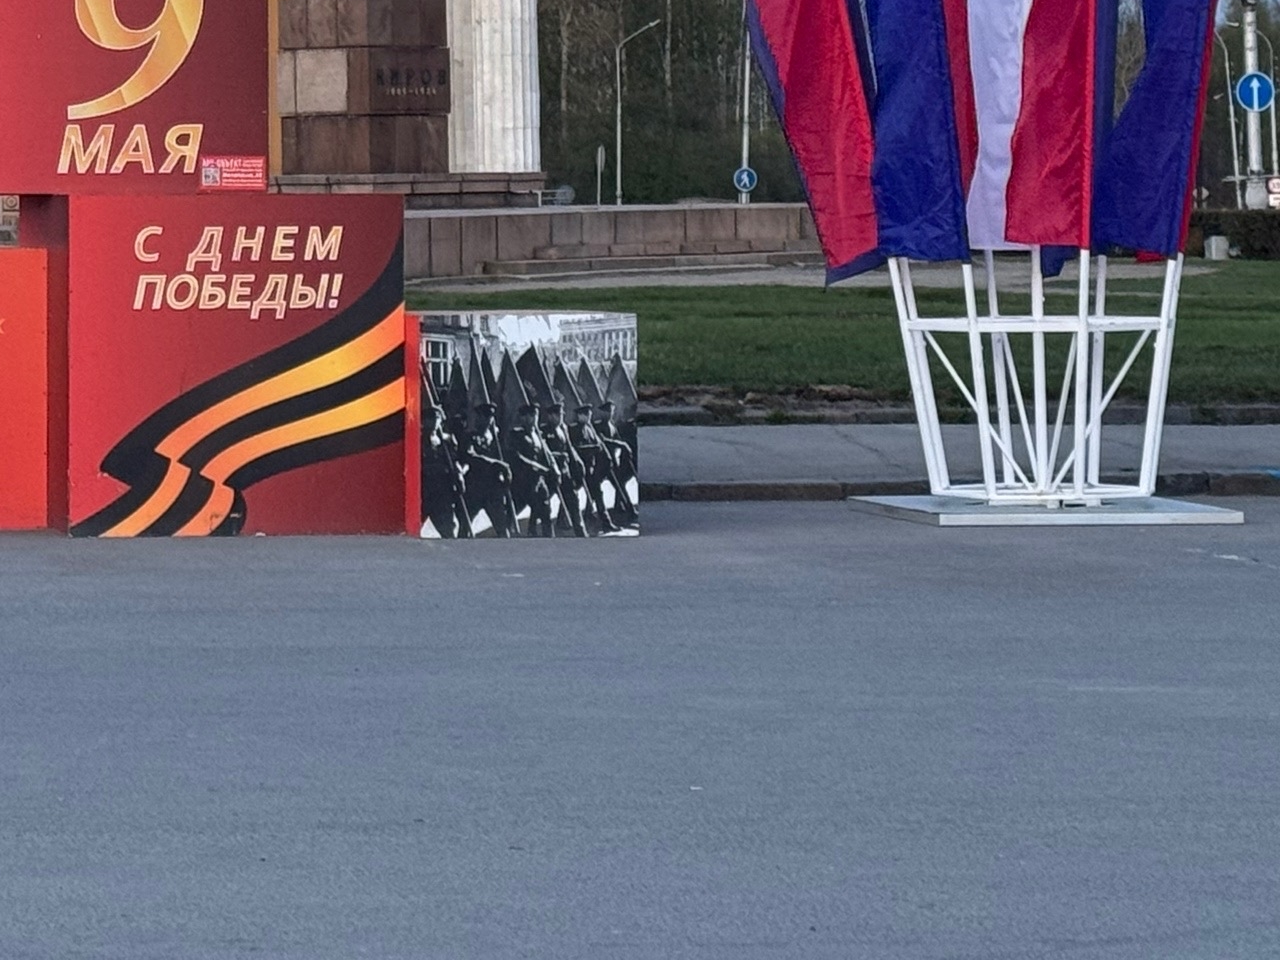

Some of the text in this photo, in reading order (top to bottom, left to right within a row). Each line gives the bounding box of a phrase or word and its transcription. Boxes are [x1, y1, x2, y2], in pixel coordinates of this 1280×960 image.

[57, 123, 204, 174] МАЯ
[134, 226, 344, 272] С ДНЕМ
[133, 273, 344, 320] ПОБЕДЫ!
